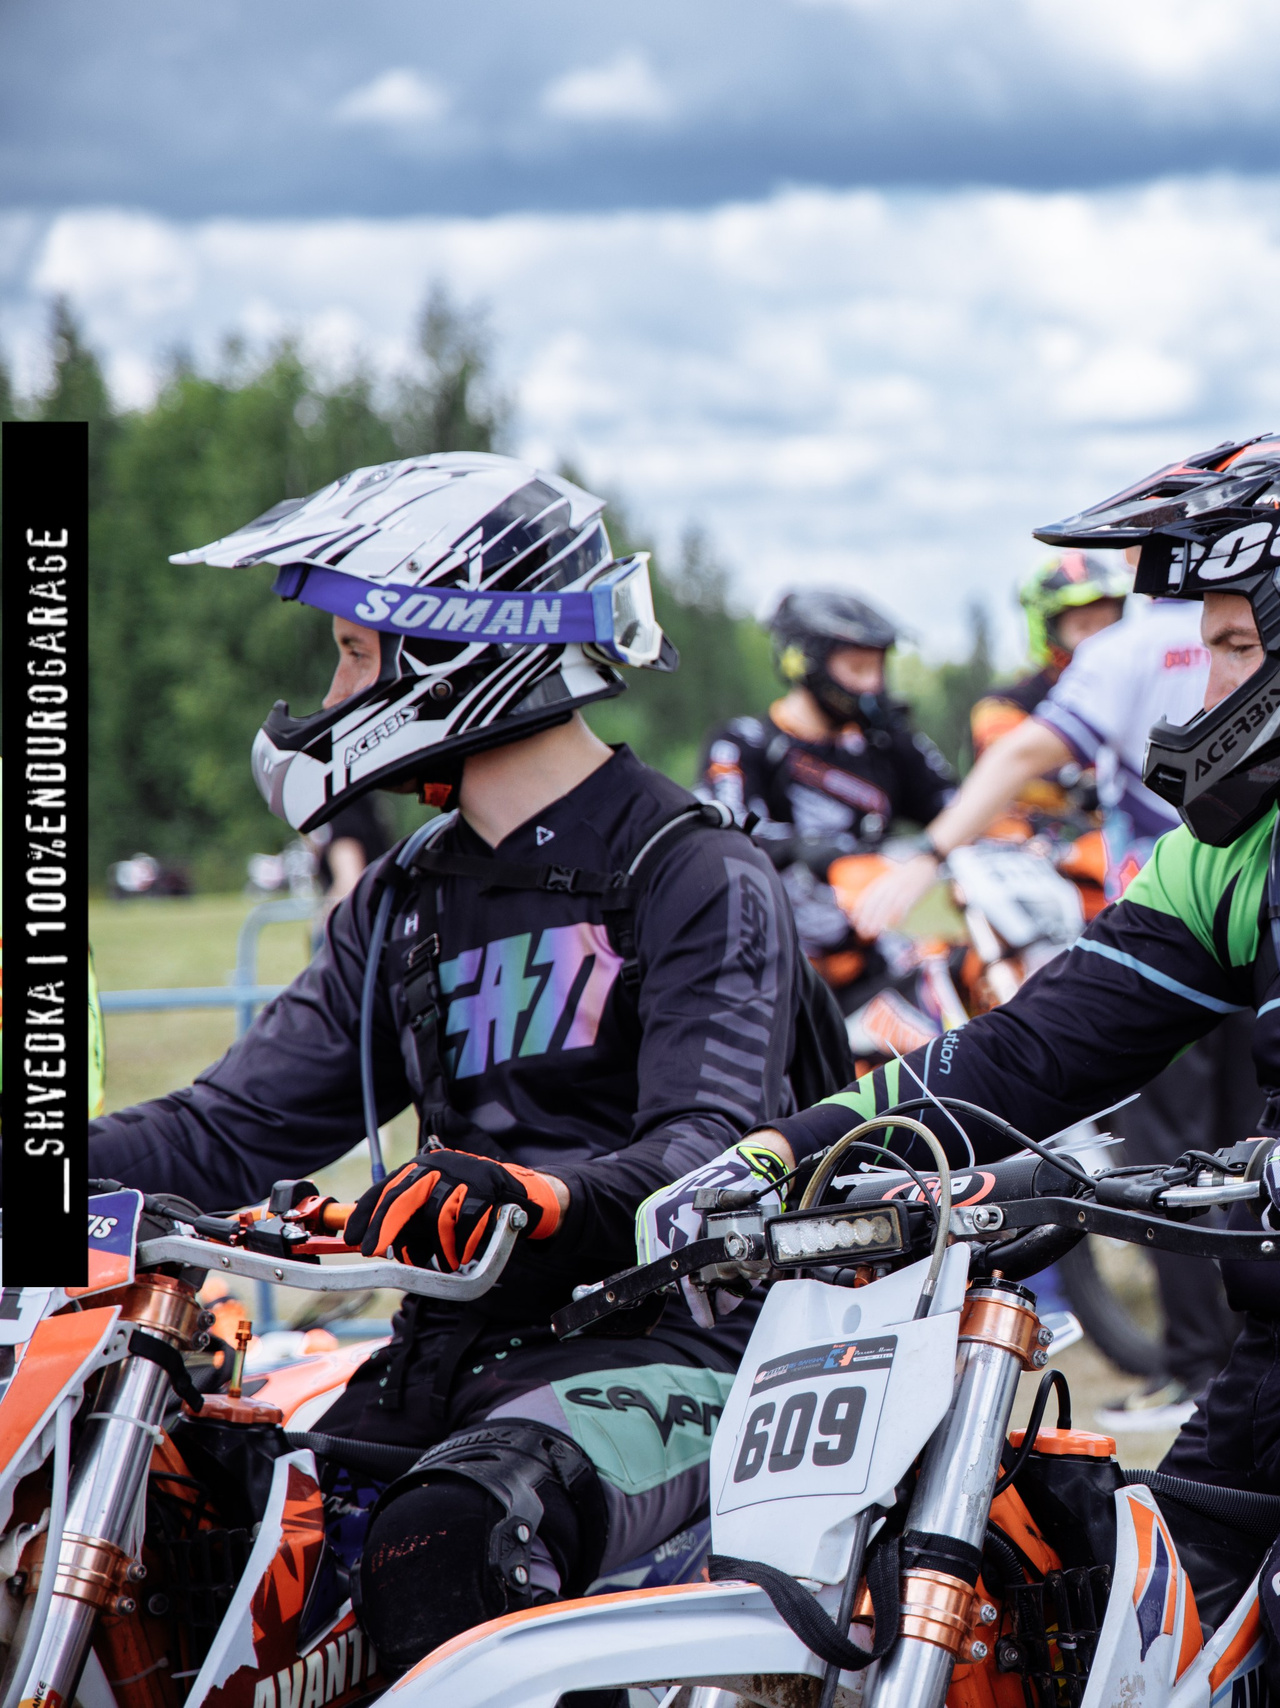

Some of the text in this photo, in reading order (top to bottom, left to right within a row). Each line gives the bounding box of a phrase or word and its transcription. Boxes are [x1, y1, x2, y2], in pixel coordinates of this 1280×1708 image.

[355, 588, 562, 636] SOMAN
[343, 705, 419, 769] ACERBIS
[733, 1386, 868, 1483] 609
